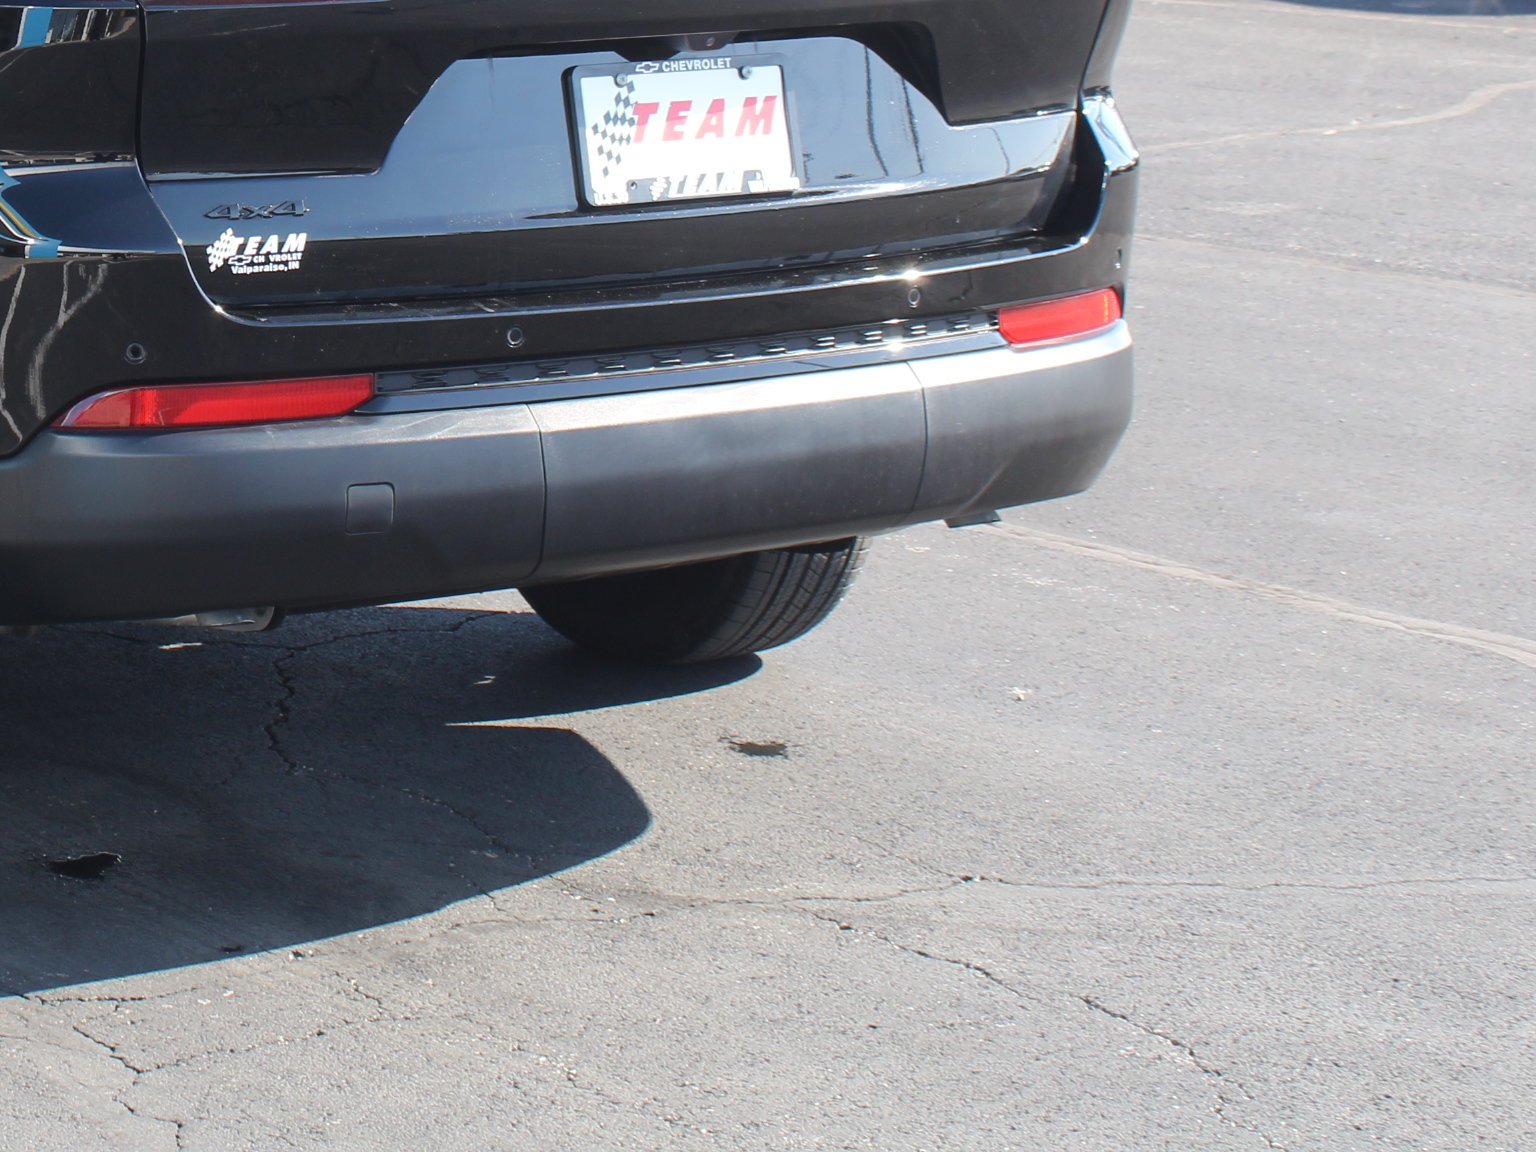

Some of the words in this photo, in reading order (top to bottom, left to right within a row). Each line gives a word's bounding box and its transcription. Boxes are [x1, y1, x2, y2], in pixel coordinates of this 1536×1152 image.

[662, 57, 732, 73] CHEVROLET
[631, 95, 778, 144] TEAM
[230, 233, 307, 257] TEAM
